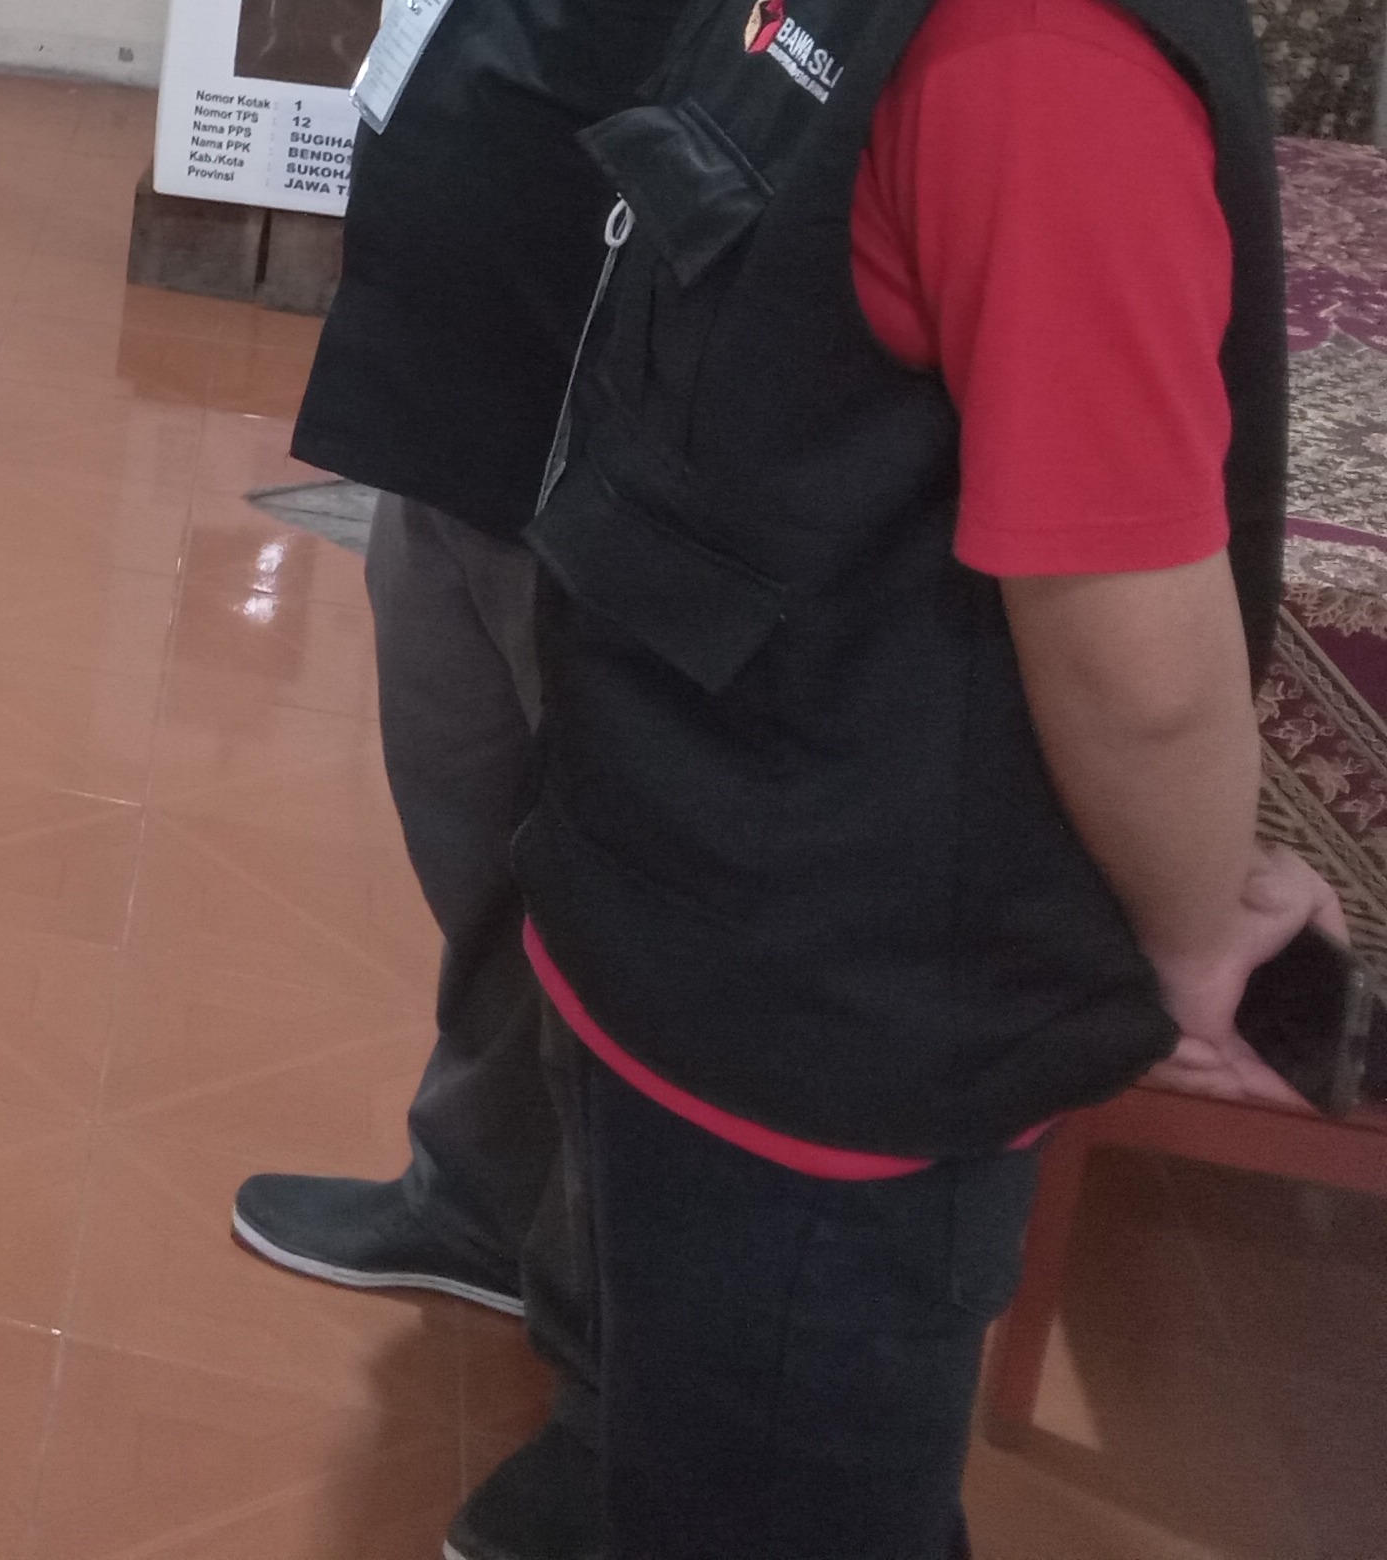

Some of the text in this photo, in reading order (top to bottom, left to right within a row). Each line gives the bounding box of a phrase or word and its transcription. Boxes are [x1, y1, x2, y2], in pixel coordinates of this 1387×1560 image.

[196, 90, 302, 111] Nomor Kotak 1
[194, 105, 311, 128] Nomor TPS 12
[191, 136, 223, 150] Nama
[225, 140, 251, 153] PPK
[192, 121, 354, 150] Nama PPS SUGIHA
[187, 165, 235, 181] Provinsi
[284, 178, 330, 194] JAWA
[286, 162, 350, 180] SUKOH
